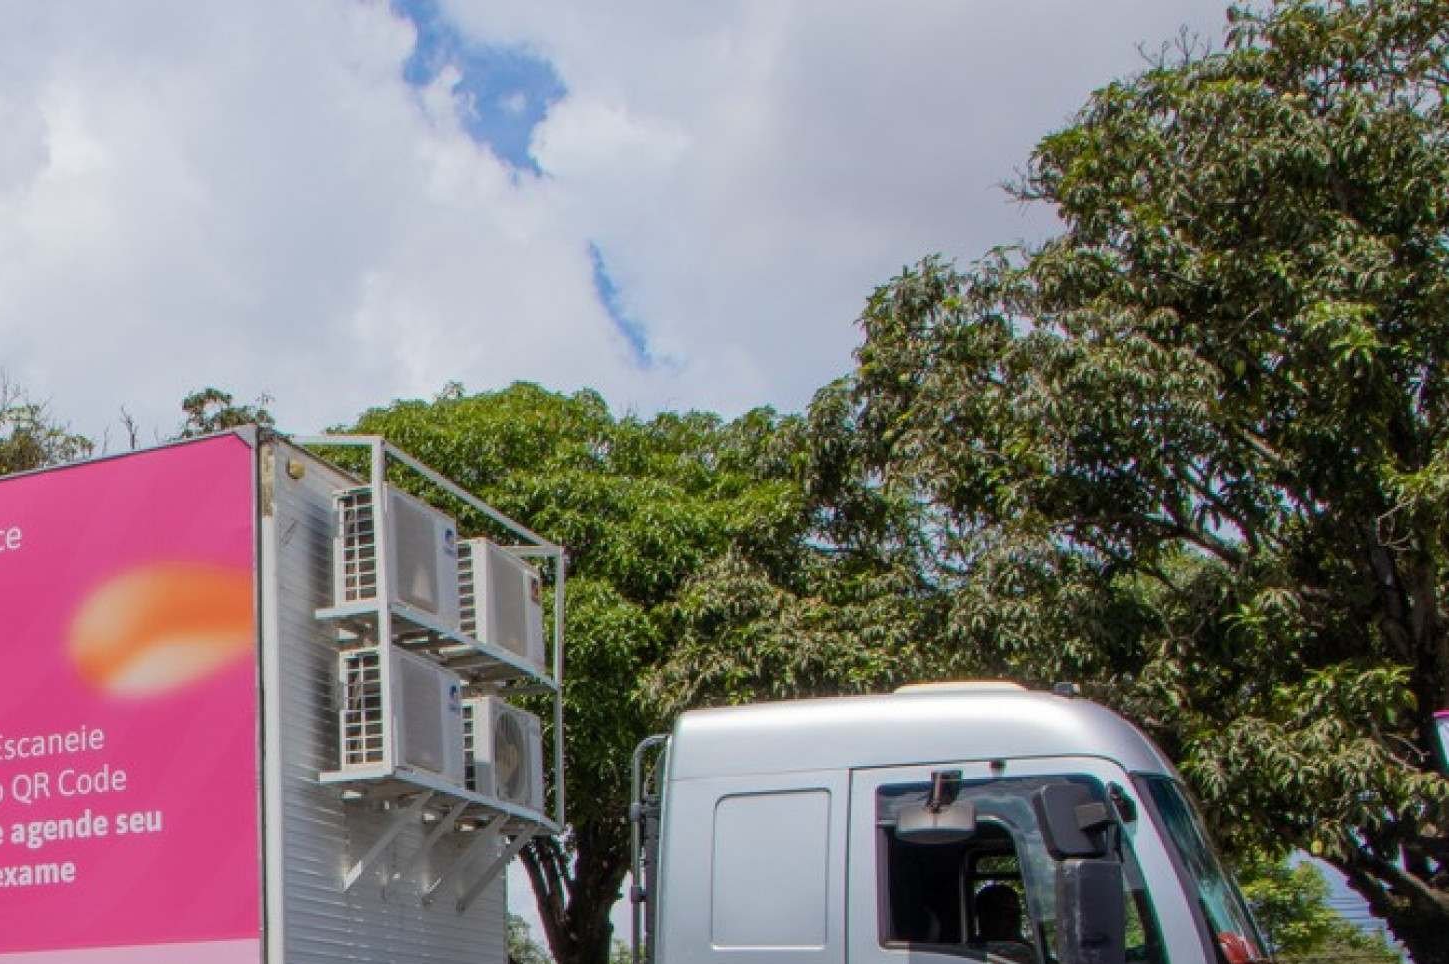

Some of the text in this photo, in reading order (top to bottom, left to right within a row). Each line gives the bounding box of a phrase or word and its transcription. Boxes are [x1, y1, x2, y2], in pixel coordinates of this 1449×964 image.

[12, 772, 50, 805] QR
[58, 764, 127, 796] Code
[11, 808, 108, 849] agende
[115, 810, 163, 835] seu
